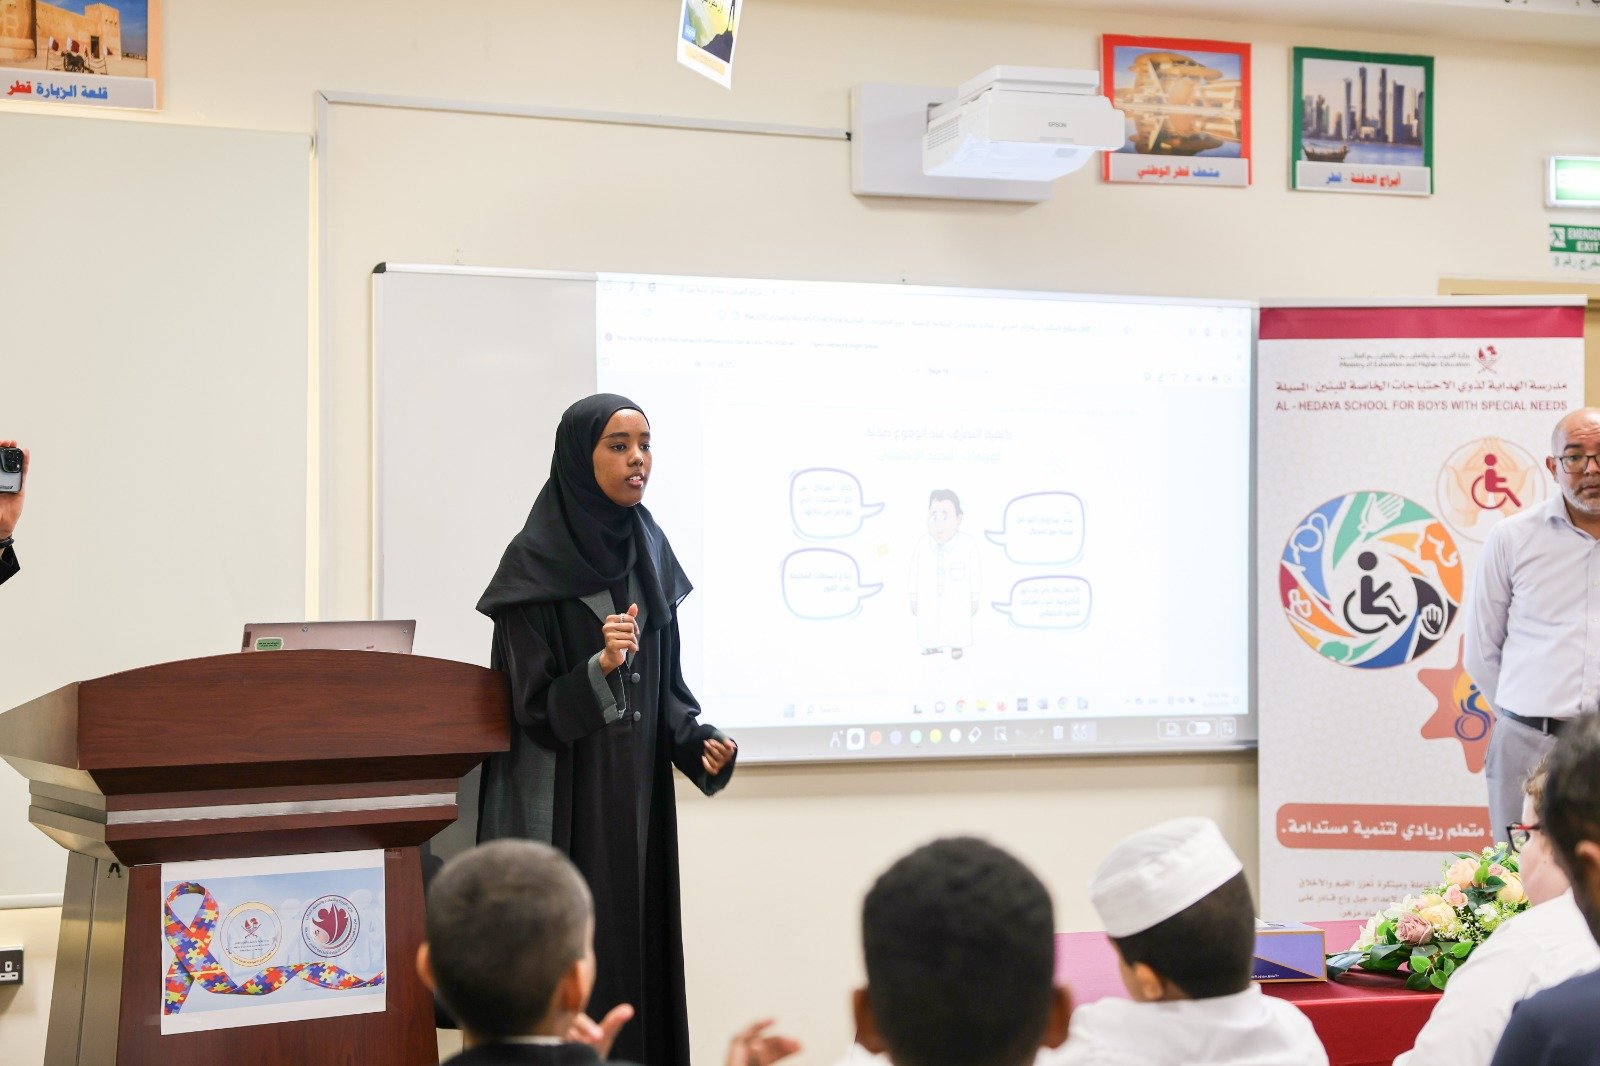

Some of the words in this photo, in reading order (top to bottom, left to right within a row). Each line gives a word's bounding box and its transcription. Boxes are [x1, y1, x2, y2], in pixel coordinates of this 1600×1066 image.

[6, 80, 32, 96] قطر
[36, 82, 77, 100] الزبارة
[81, 85, 108, 100] قلعة
[1047, 120, 1068, 129] EPSON
[1137, 164, 1170, 180] الوطني
[1172, 165, 1189, 179] قطر
[1192, 166, 1220, 178] متحف
[1325, 171, 1342, 185] قطر
[1349, 380, 1390, 392] الخاصة
[1457, 381, 1486, 393] لذوي
[1488, 380, 1528, 393] الهداية
[1529, 380, 1568, 393] مدرسة
[1276, 401, 1289, 411] AL
[1299, 400, 1342, 411] HEDAYA
[1344, 400, 1389, 411] SCHOOL
[1392, 400, 1415, 411] FOR
[1418, 400, 1448, 411] BOYS
[1451, 400, 1479, 411] WITH
[1481, 400, 1527, 411] SPECIAL
[1530, 400, 1568, 411] NEEDS
[1281, 818, 1350, 836] مستدامة.
[1352, 820, 1399, 840] لتنمية
[1401, 822, 1444, 841] ريادي
[1446, 823, 1486, 840] متعلم
